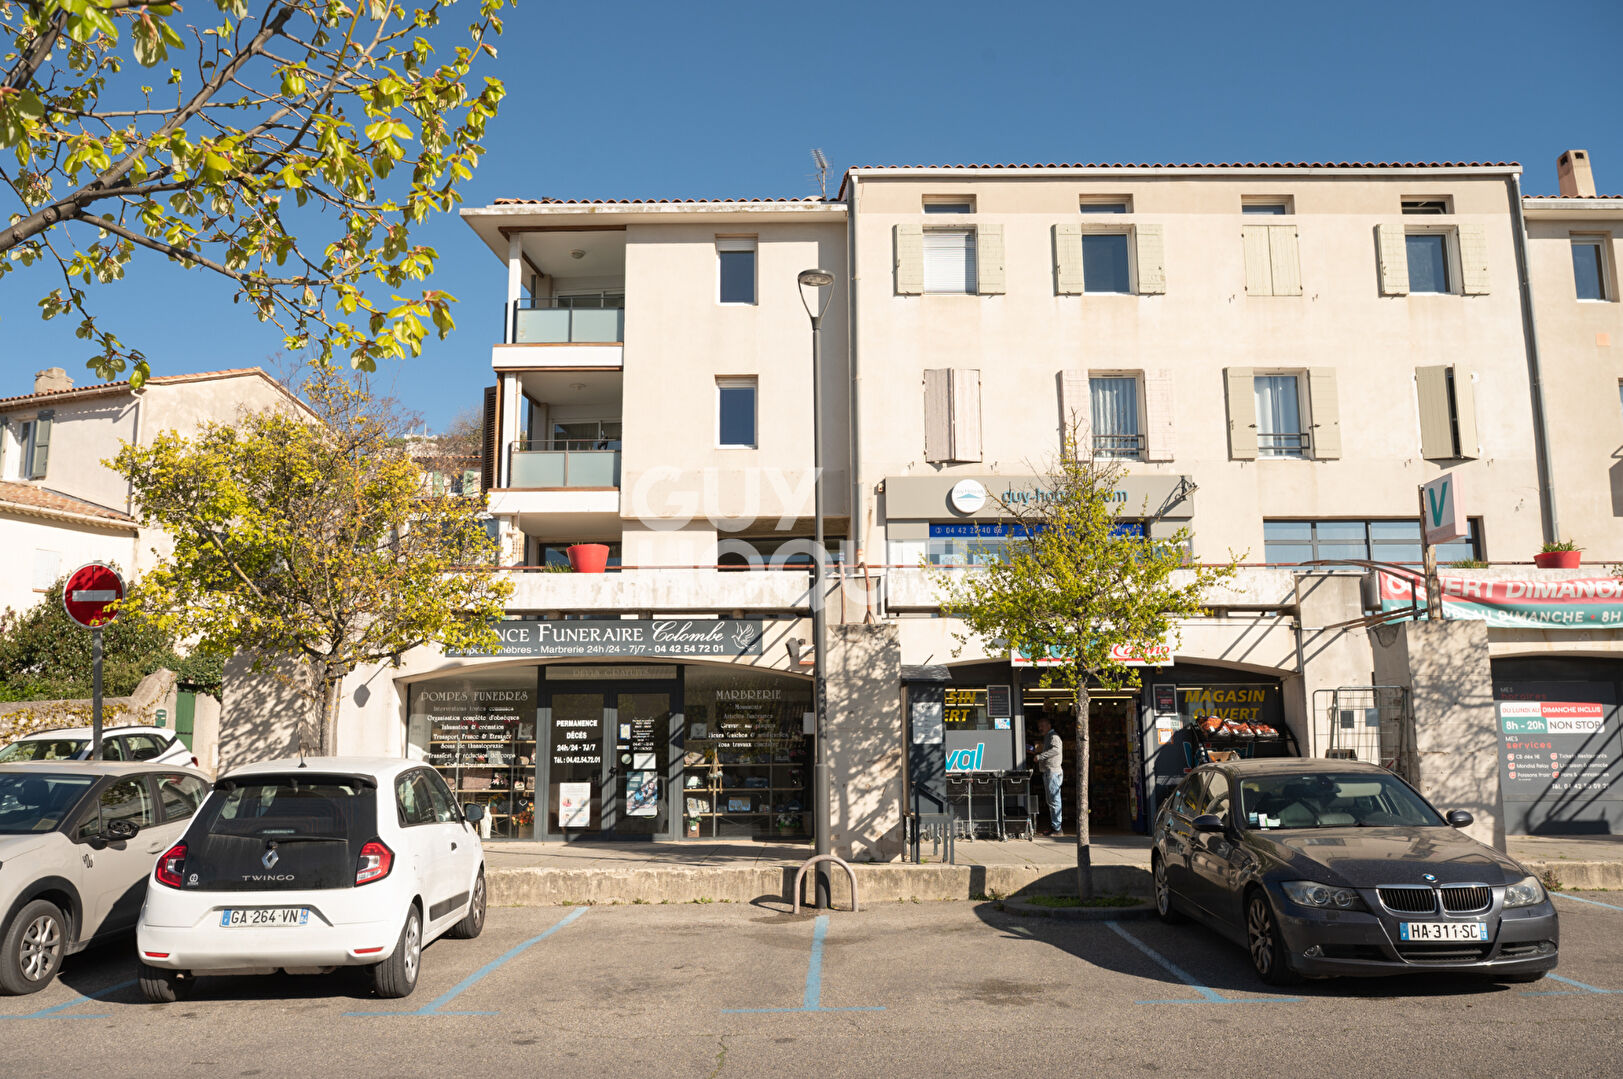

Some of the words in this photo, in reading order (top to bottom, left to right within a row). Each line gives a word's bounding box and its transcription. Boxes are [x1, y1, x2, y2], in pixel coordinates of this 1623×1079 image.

[1428, 481, 1448, 527] V
[1498, 609, 1585, 623] DIMANCHE
[1601, 611, 1621, 623] 8H
[537, 623, 644, 643] FUNERAIRE
[651, 621, 725, 642] Colombe
[540, 645, 585, 654] Marbrerie
[654, 645, 667, 653] 04
[669, 645, 681, 653] 42
[683, 645, 696, 653] 54
[699, 645, 710, 653] 72
[712, 645, 724, 653] 01
[421, 691, 468, 701] POMPES
[473, 691, 529, 701] FUNEBRES
[716, 690, 781, 700] MARBRERIE
[1184, 690, 1266, 703] MAGASIN
[556, 719, 598, 727] PERMANENCE
[1505, 721, 1519, 730] 8h
[1527, 721, 1545, 730] 20h
[1549, 721, 1573, 729] NON
[1575, 721, 1600, 729] STOP
[1506, 741, 1552, 750] services
[945, 743, 984, 771] val
